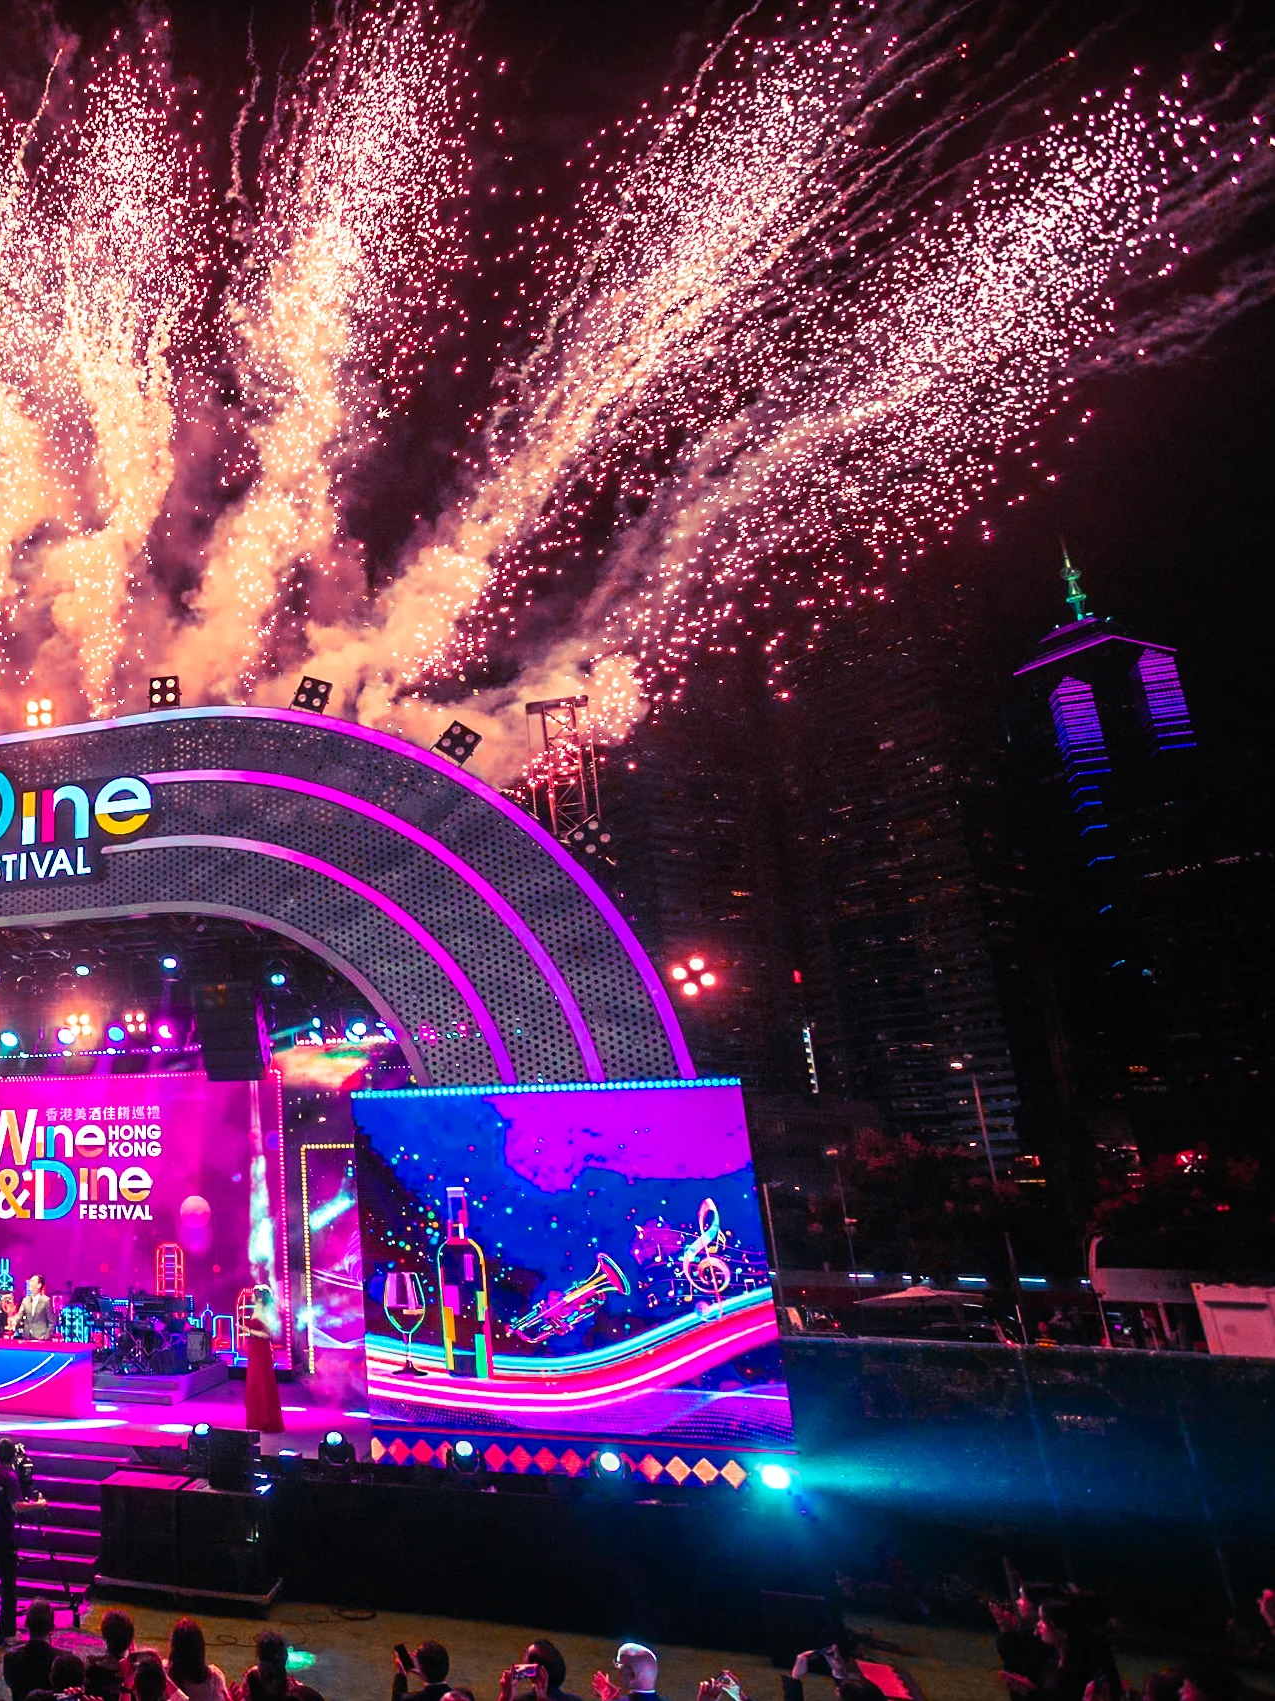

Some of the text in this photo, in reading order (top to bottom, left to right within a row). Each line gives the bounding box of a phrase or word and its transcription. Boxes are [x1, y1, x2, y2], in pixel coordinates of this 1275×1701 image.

[108, 1124, 162, 1140] HONG
[108, 1141, 162, 1157] KONG
[79, 1204, 154, 1220] FESTIVAL
